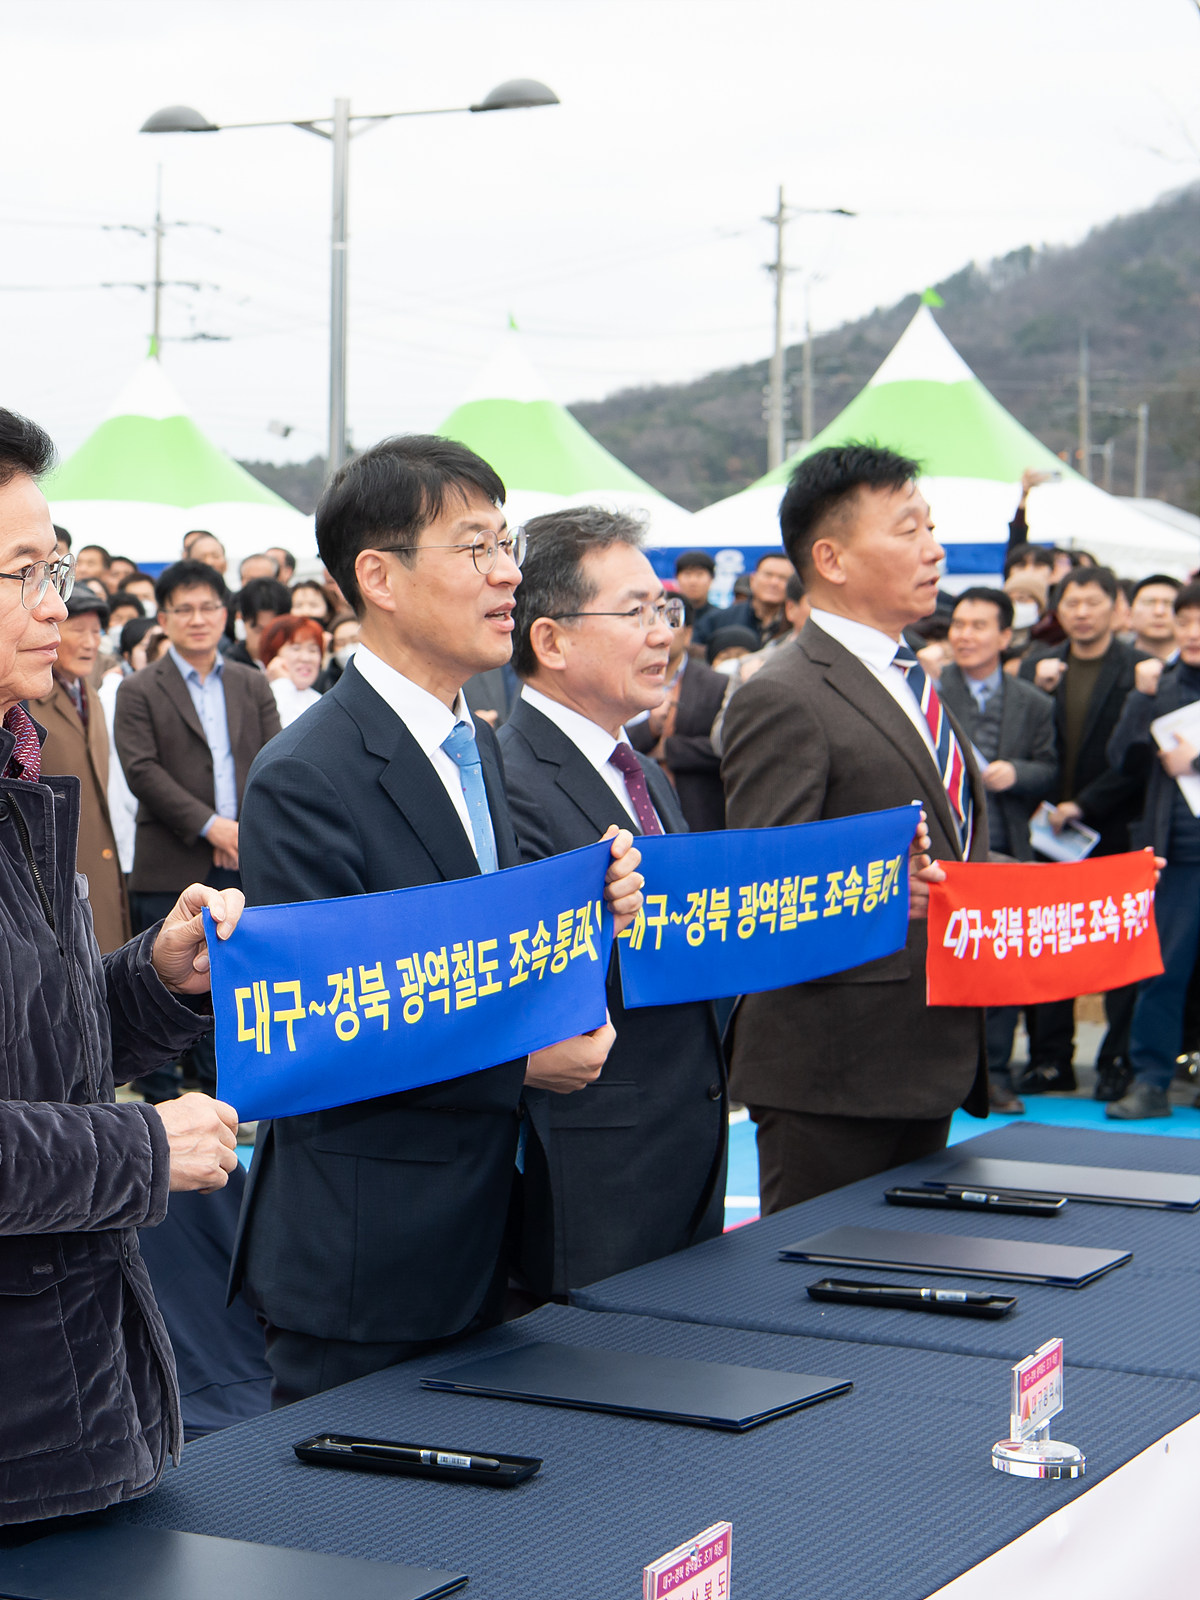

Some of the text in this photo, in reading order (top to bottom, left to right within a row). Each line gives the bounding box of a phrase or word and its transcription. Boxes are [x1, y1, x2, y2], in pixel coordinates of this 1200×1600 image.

[737, 876, 818, 939] 광역철도
[943, 907, 1024, 960] 대구~경북
[1027, 902, 1087, 957] 광역철도
[1089, 896, 1121, 944] 조속
[234, 961, 390, 1053] 대구~경북
[396, 938, 502, 1024] 광역철도
